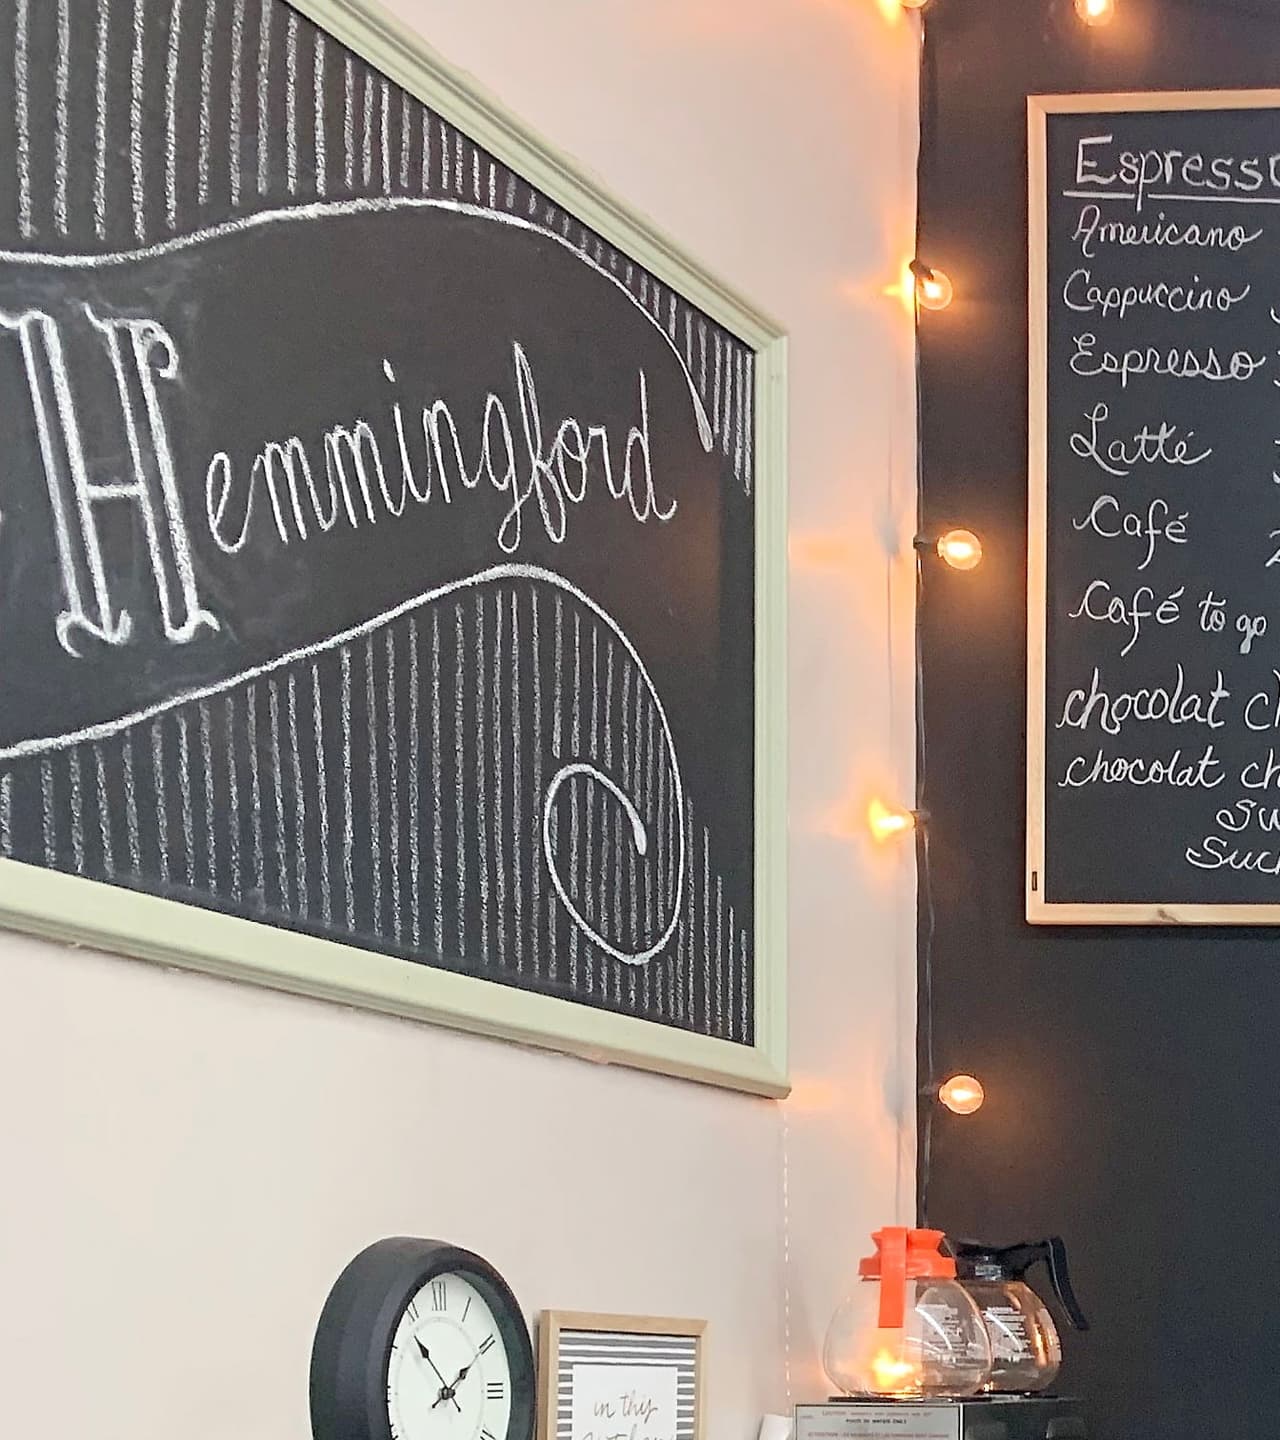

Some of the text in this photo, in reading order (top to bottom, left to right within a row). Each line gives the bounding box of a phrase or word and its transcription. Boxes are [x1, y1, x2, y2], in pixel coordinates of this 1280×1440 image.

[1071, 205, 1263, 257] Americano
[1063, 269, 1250, 318] Cappuccino
[1069, 333, 1266, 387] Espresso
[1070, 403, 1212, 475] Latté
[0, 302, 676, 658] Hemmingford
[1072, 494, 1189, 570] Café
[1069, 579, 1185, 657] Café
[1198, 591, 1226, 632] to
[1235, 613, 1268, 654] go
[1056, 664, 1231, 735] chocolat
[1057, 744, 1226, 788] chocolat
[594, 1400, 615, 1418] in
